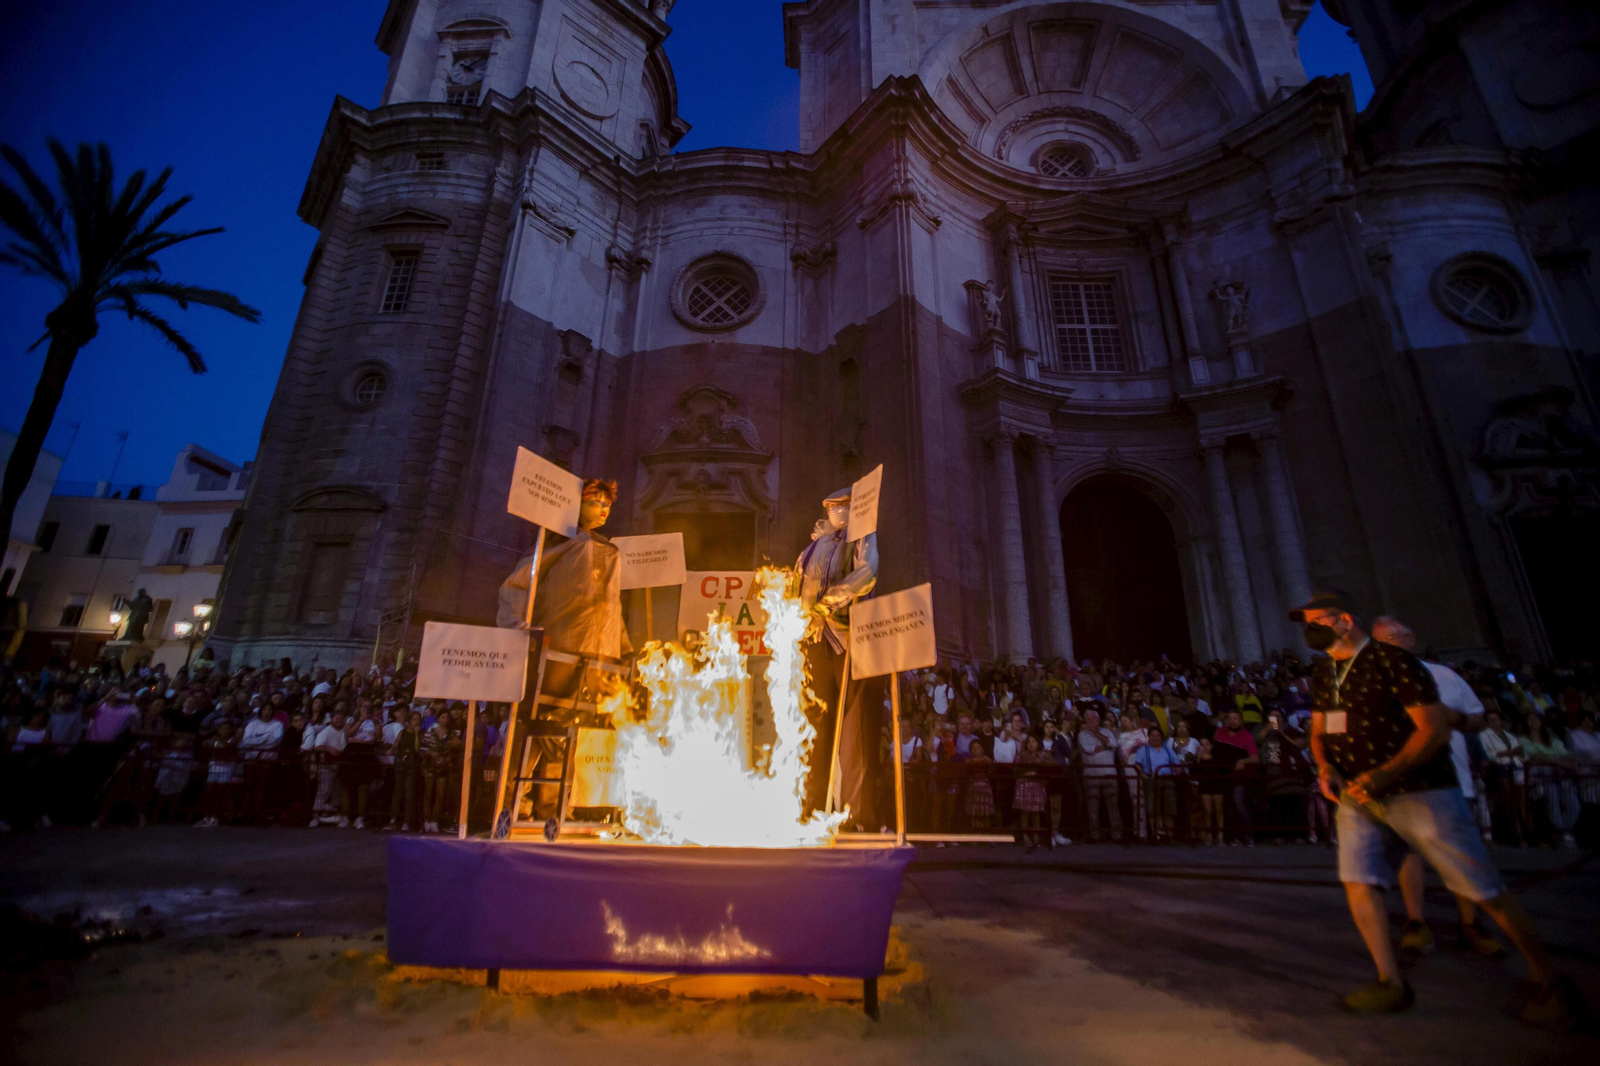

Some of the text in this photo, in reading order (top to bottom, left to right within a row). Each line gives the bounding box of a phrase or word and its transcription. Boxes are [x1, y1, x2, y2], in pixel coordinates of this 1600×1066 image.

[534, 473, 563, 492] ESTAMOS
[521, 476, 554, 497] EXPUESTO
[558, 494, 572, 505] QUE
[527, 488, 561, 508] NOS ROBEN
[626, 555, 668, 565] UTILIZARLO
[636, 549, 668, 557] SABEMOS
[857, 619, 892, 633] TENEMOS
[892, 610, 918, 623] MIEDO
[856, 633, 871, 645] QUE
[872, 630, 889, 639] NOS
[441, 649, 509, 660] TENEMOS QUE
[441, 658, 506, 669] PEDIR AYUDA
